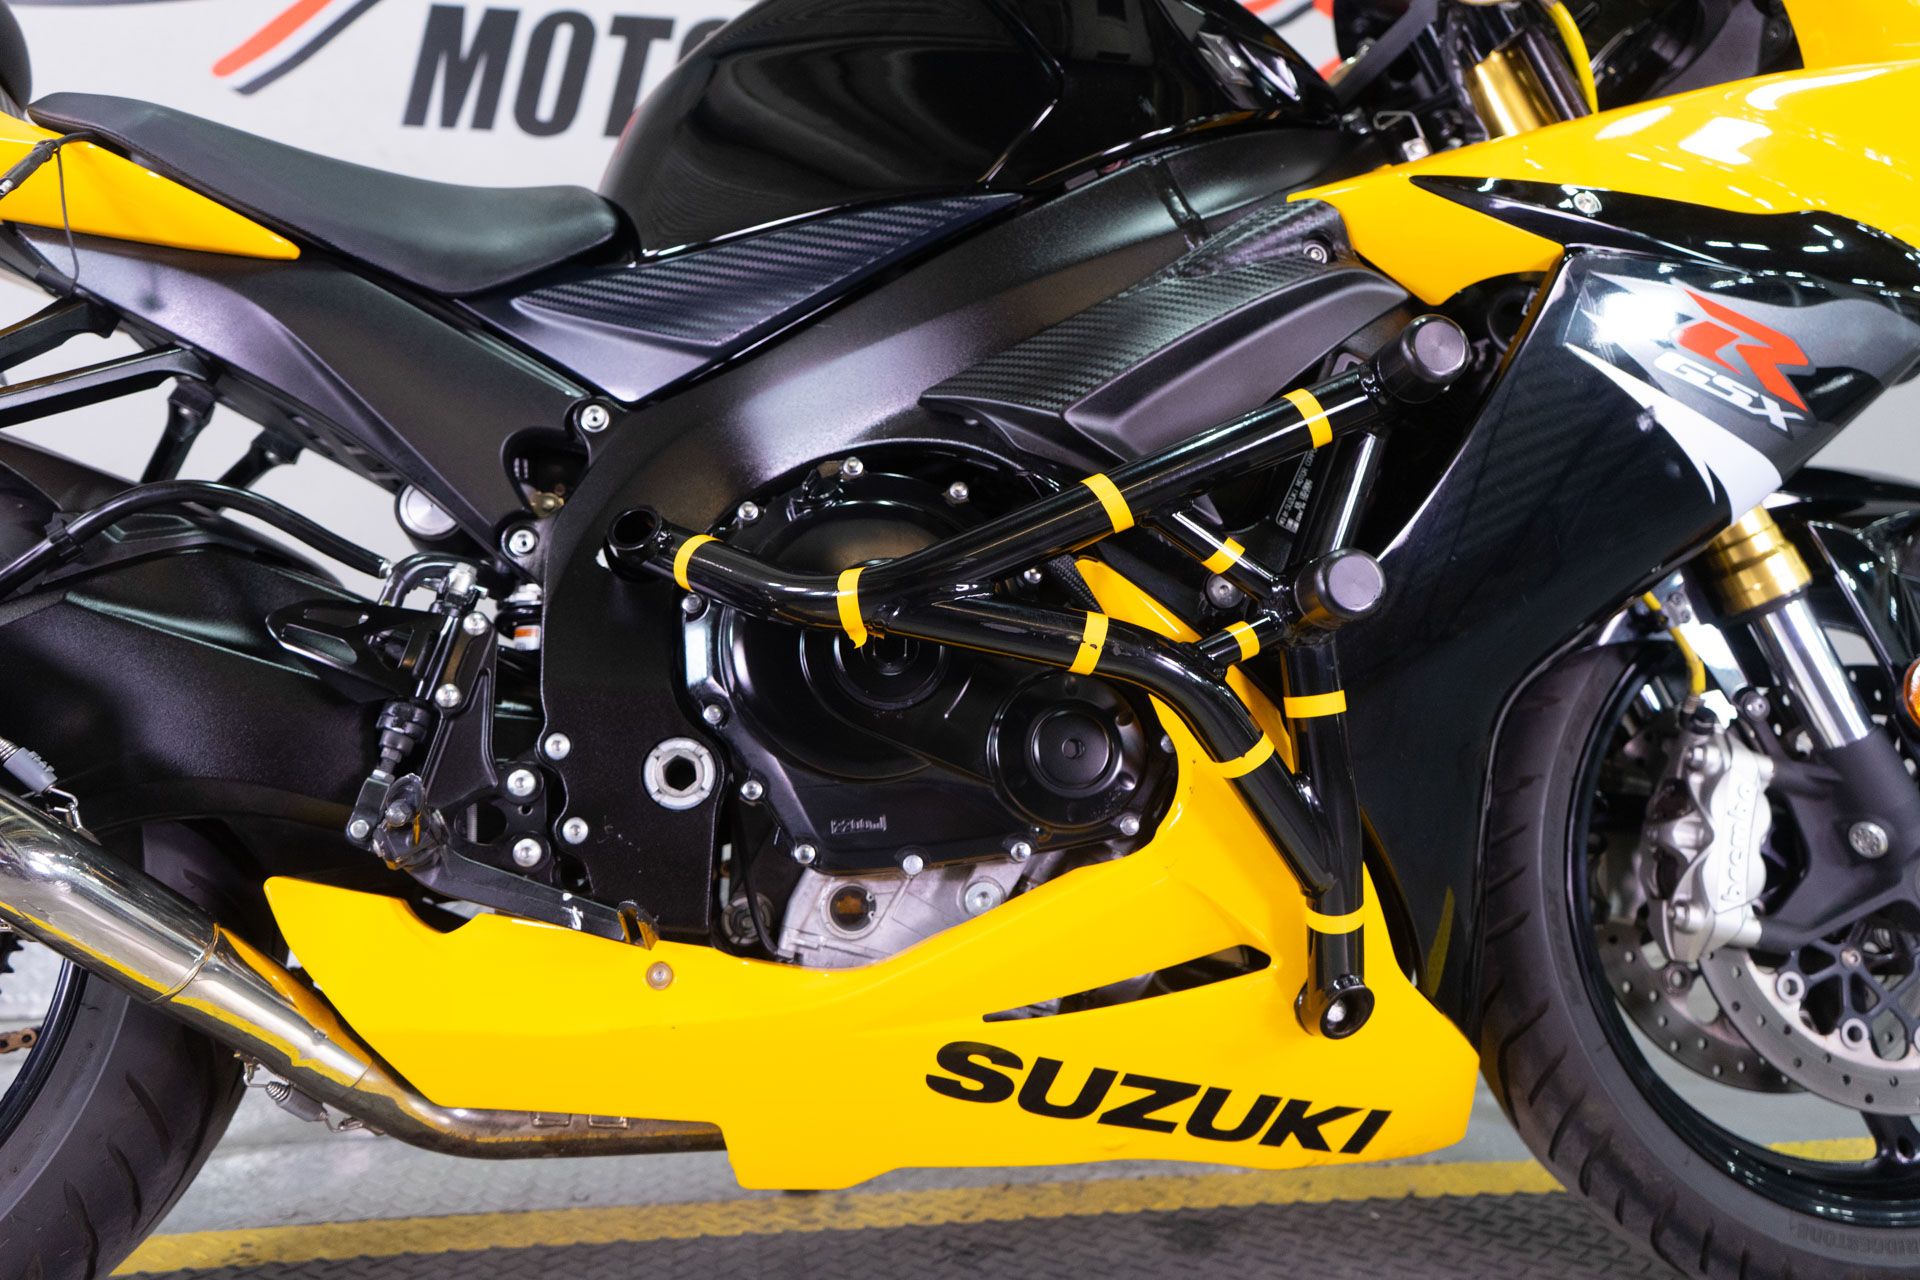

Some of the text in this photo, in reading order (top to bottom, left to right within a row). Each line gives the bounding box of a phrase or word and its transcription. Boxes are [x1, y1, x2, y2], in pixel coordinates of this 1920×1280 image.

[403, 4, 728, 138] MOT
[1654, 352, 1805, 432] GSX
[926, 1041, 1392, 1154] SUZUKI
